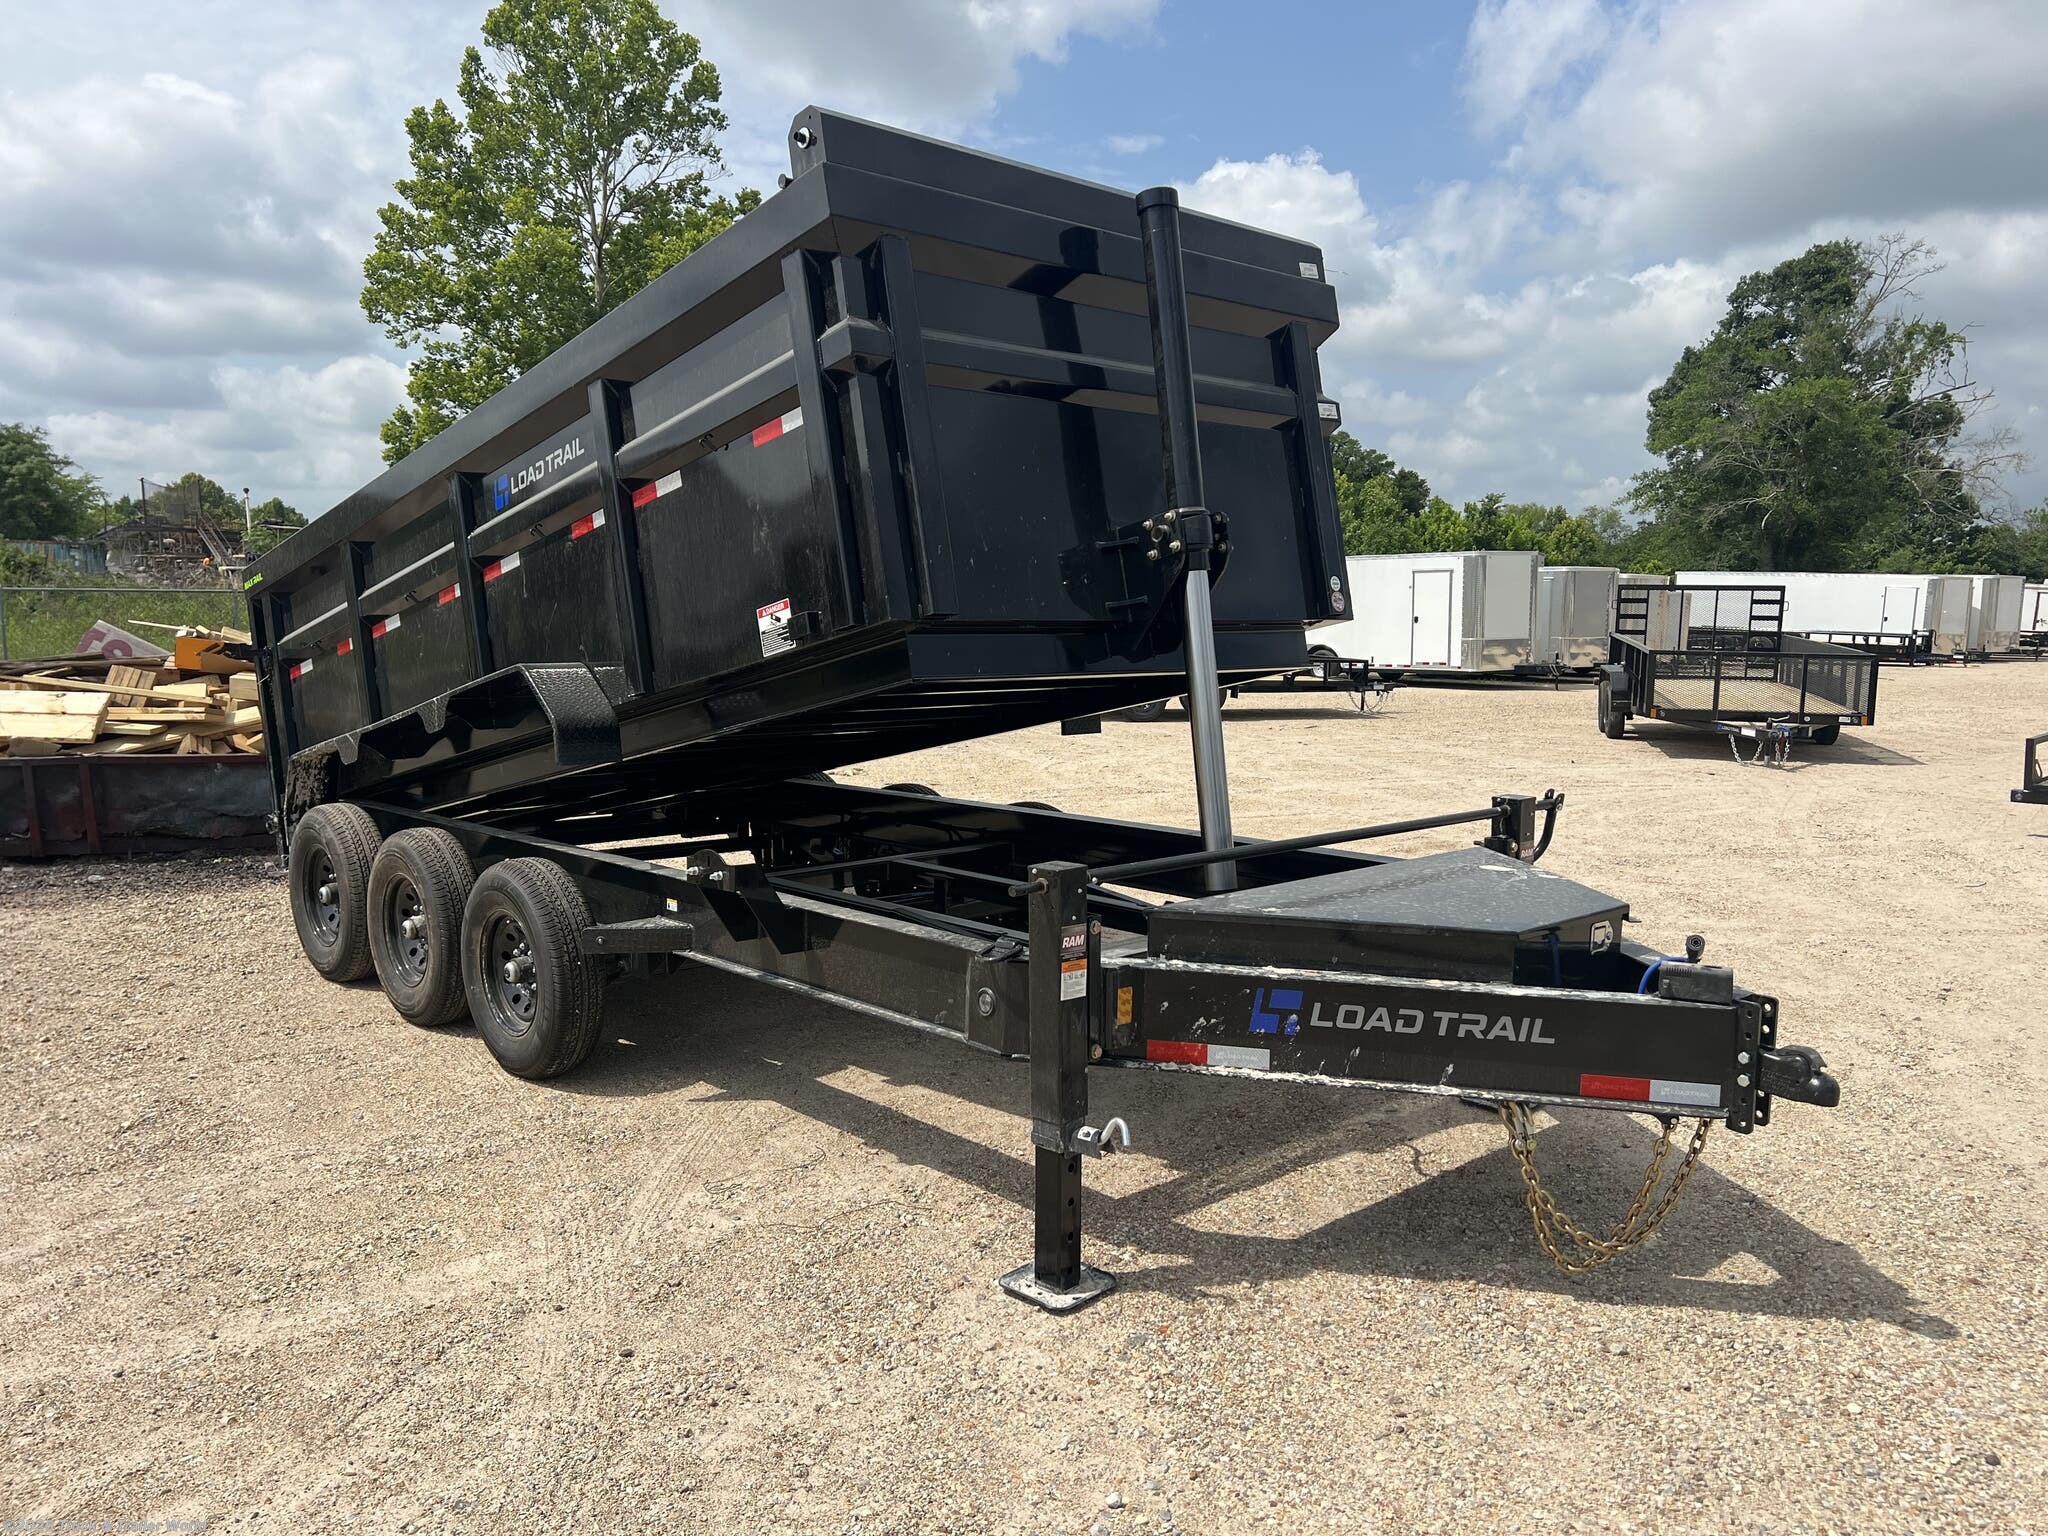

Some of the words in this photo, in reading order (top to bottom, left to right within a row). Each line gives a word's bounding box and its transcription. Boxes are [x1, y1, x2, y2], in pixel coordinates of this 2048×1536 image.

[511, 460, 545, 494] LOAD
[545, 437, 585, 473] TRAIL
[1062, 934, 1085, 949] RAM
[1310, 1002, 1424, 1034] LOAD
[1432, 1010, 1556, 1045] TRAIL
